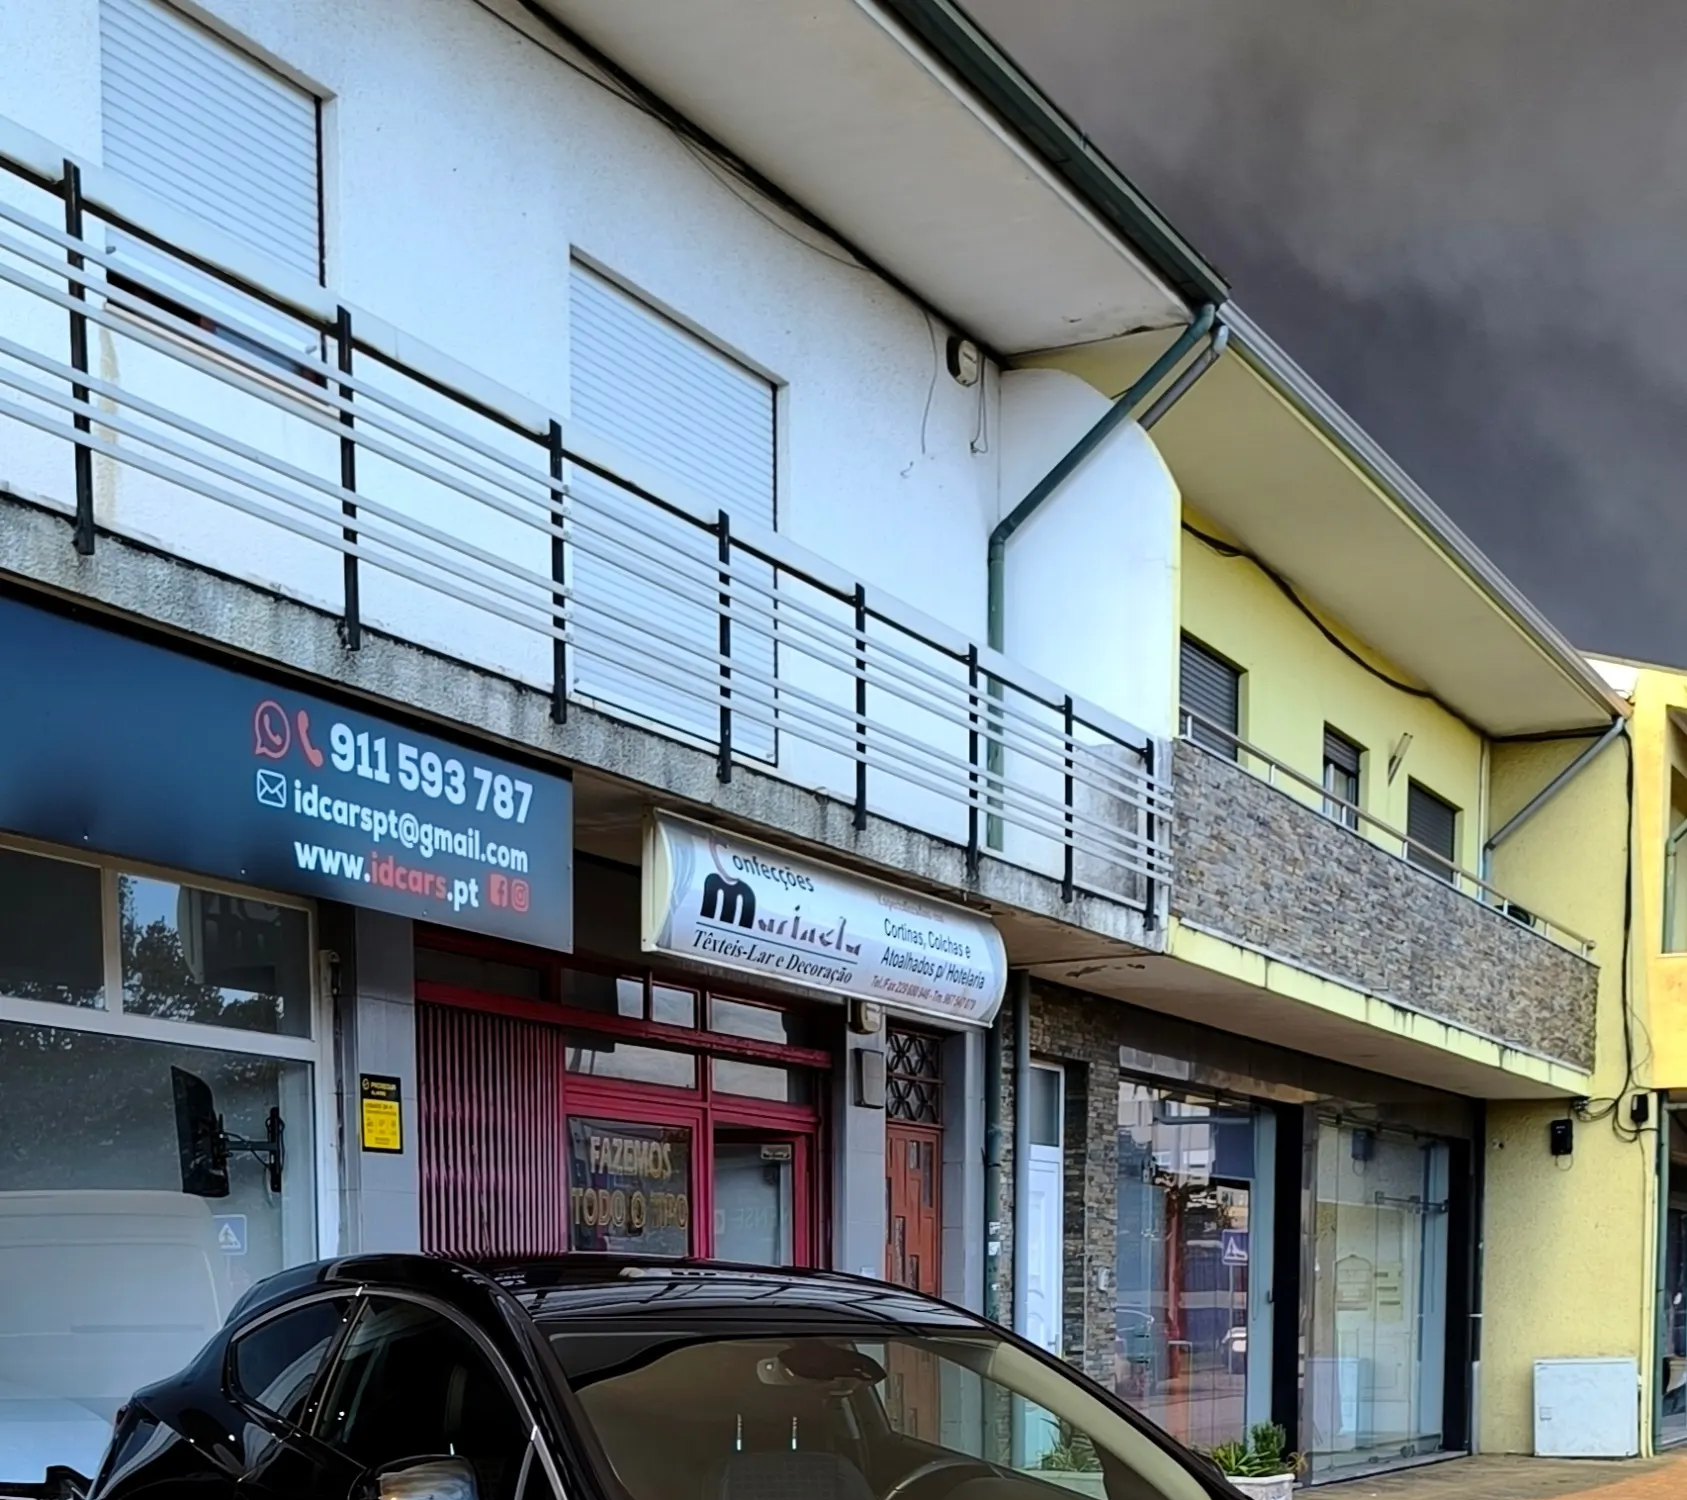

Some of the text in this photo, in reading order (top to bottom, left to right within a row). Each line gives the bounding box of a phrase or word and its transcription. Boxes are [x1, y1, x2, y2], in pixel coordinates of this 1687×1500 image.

[330, 723, 534, 824] 911 593 787
[294, 780, 529, 873] idcarspt@gmail.com
[294, 841, 480, 912] www.idcars.pt
[709, 835, 815, 892] Confecções
[692, 929, 853, 984] Têxteis-Lar e Decoração
[884, 918, 972, 959] Cortinas, Colchas e
[881, 946, 935, 976] Atoalhados
[946, 964, 986, 990] Hotelaria
[590, 1136, 672, 1179] FAZEMOS
[572, 1187, 627, 1227] TODO
[631, 1190, 646, 1228] O
